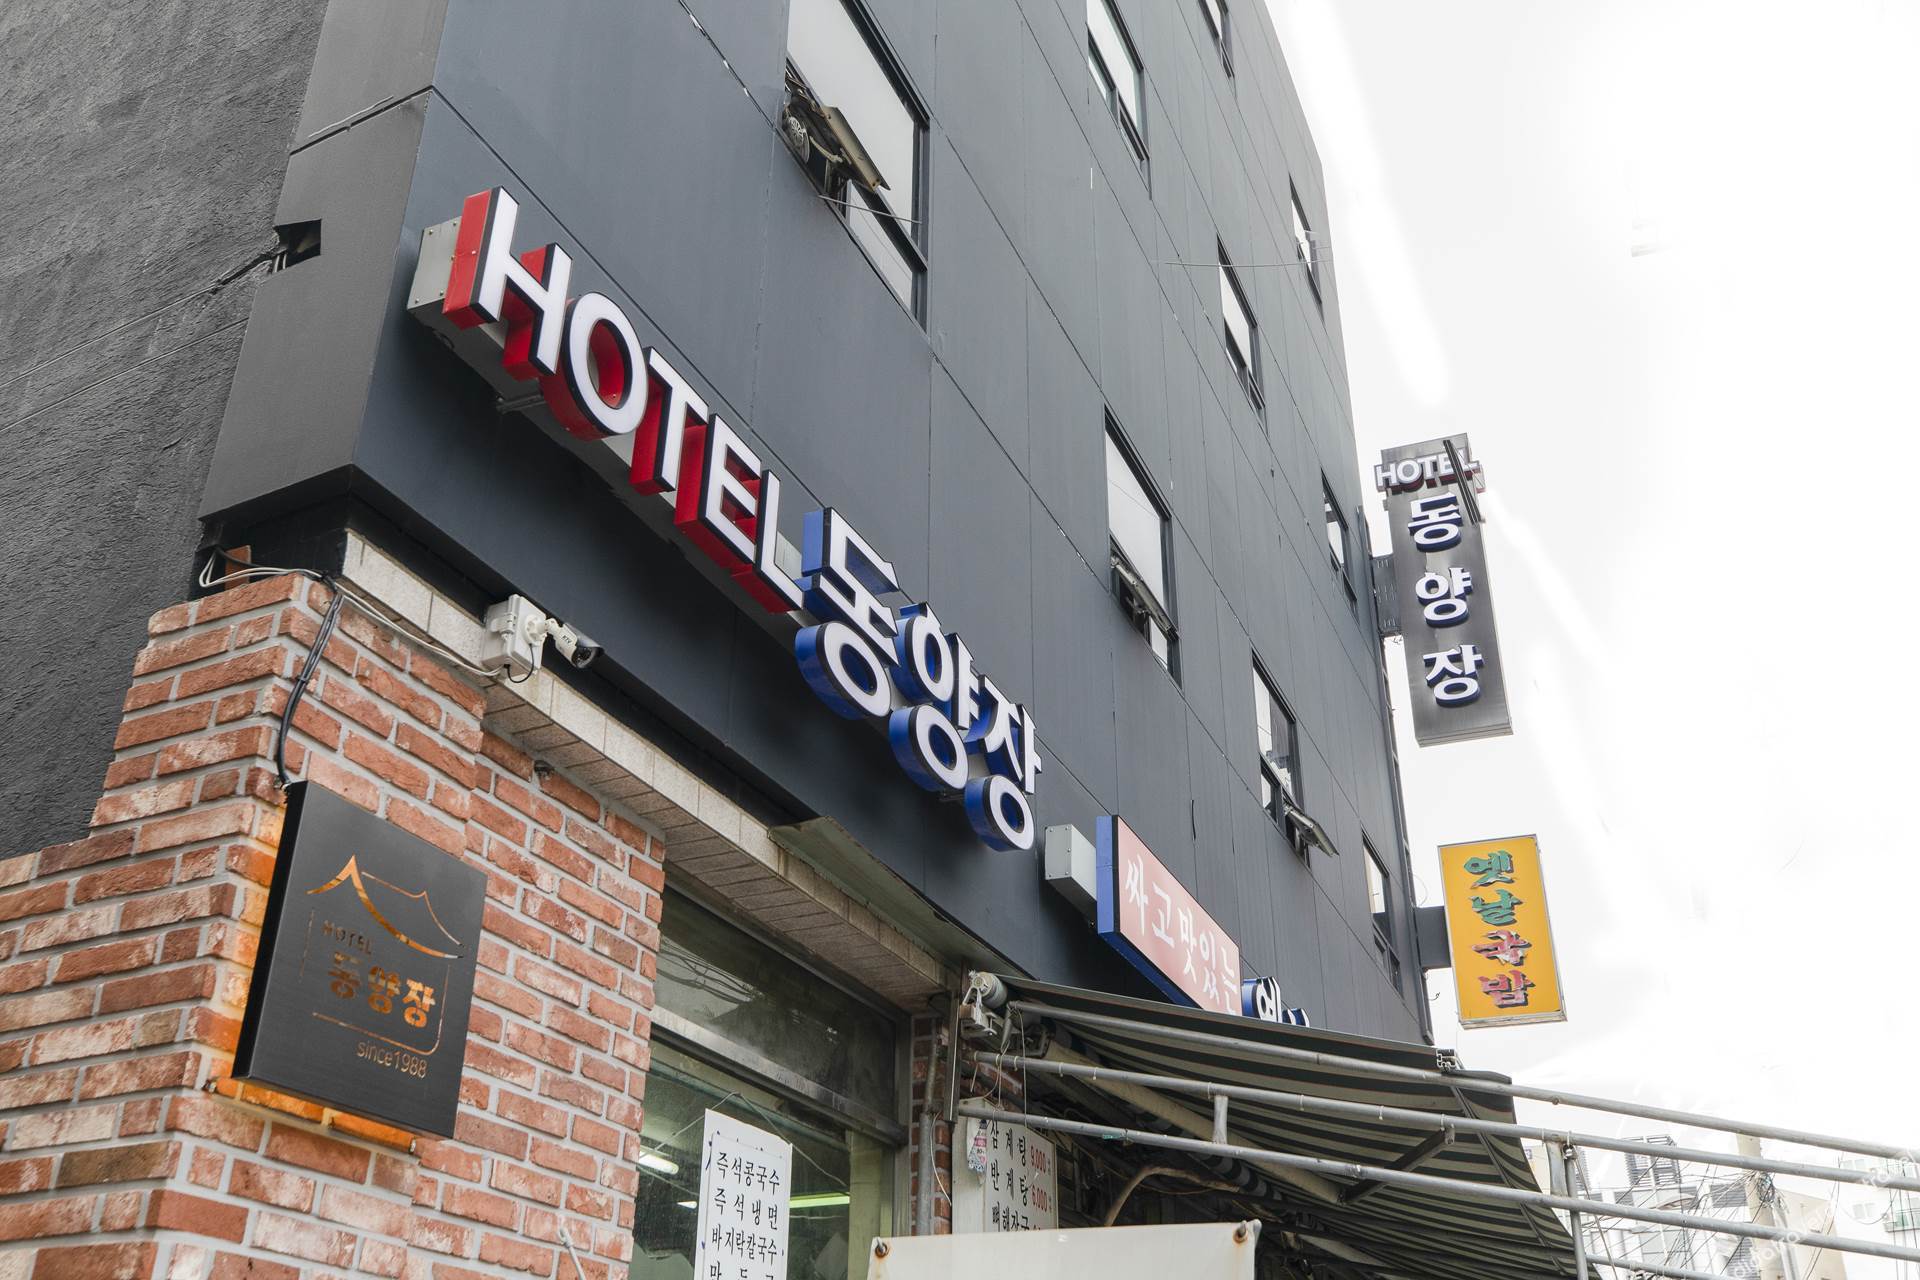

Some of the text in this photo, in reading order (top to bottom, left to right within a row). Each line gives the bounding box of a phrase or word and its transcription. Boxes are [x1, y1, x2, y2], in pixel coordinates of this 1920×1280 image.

[462, 186, 803, 612] HOTEL
[1375, 449, 1480, 488] HOTEL
[1408, 492, 1484, 704] 동양장
[798, 507, 1043, 851] 동양장
[322, 920, 372, 954] HOTEL
[328, 951, 435, 1028] 동양장
[717, 1152, 780, 1195] 즉석콩국수
[712, 1224, 778, 1266] 바지락칼국수
